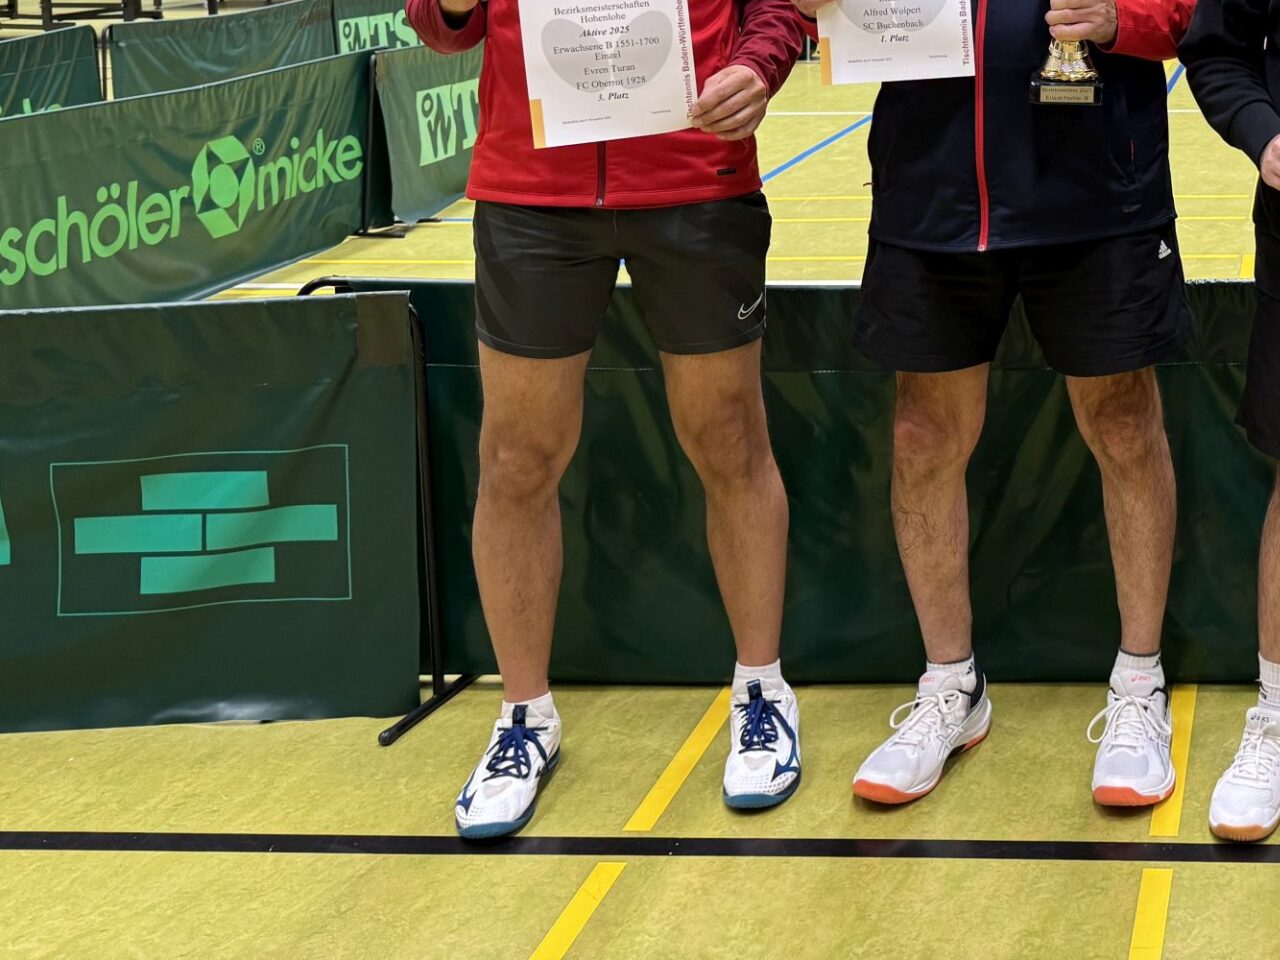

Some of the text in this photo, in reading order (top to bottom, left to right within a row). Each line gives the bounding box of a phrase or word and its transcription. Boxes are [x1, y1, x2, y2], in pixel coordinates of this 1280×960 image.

[553, 0, 650, 16] Bezirksmeisterschaften
[863, 7, 922, 17] Alfred Wolpert
[580, 12, 626, 24] Hohenlohe
[862, 19, 924, 31] SC Buchenbach
[579, 25, 630, 38] Aktive 2025
[890, 34, 910, 43] Platz
[962, 18, 970, 66] Tischtennis
[553, 36, 660, 55] Erwachsene B 1551-1700
[594, 50, 621, 61] Einzel
[584, 64, 635, 76] Evren Turan
[576, 75, 646, 90] FC Oberrot 1928
[597, 92, 630, 102] 3. Platz
[686, 73, 699, 120] Tischtennis
[0, 128, 364, 286] schöler micke
